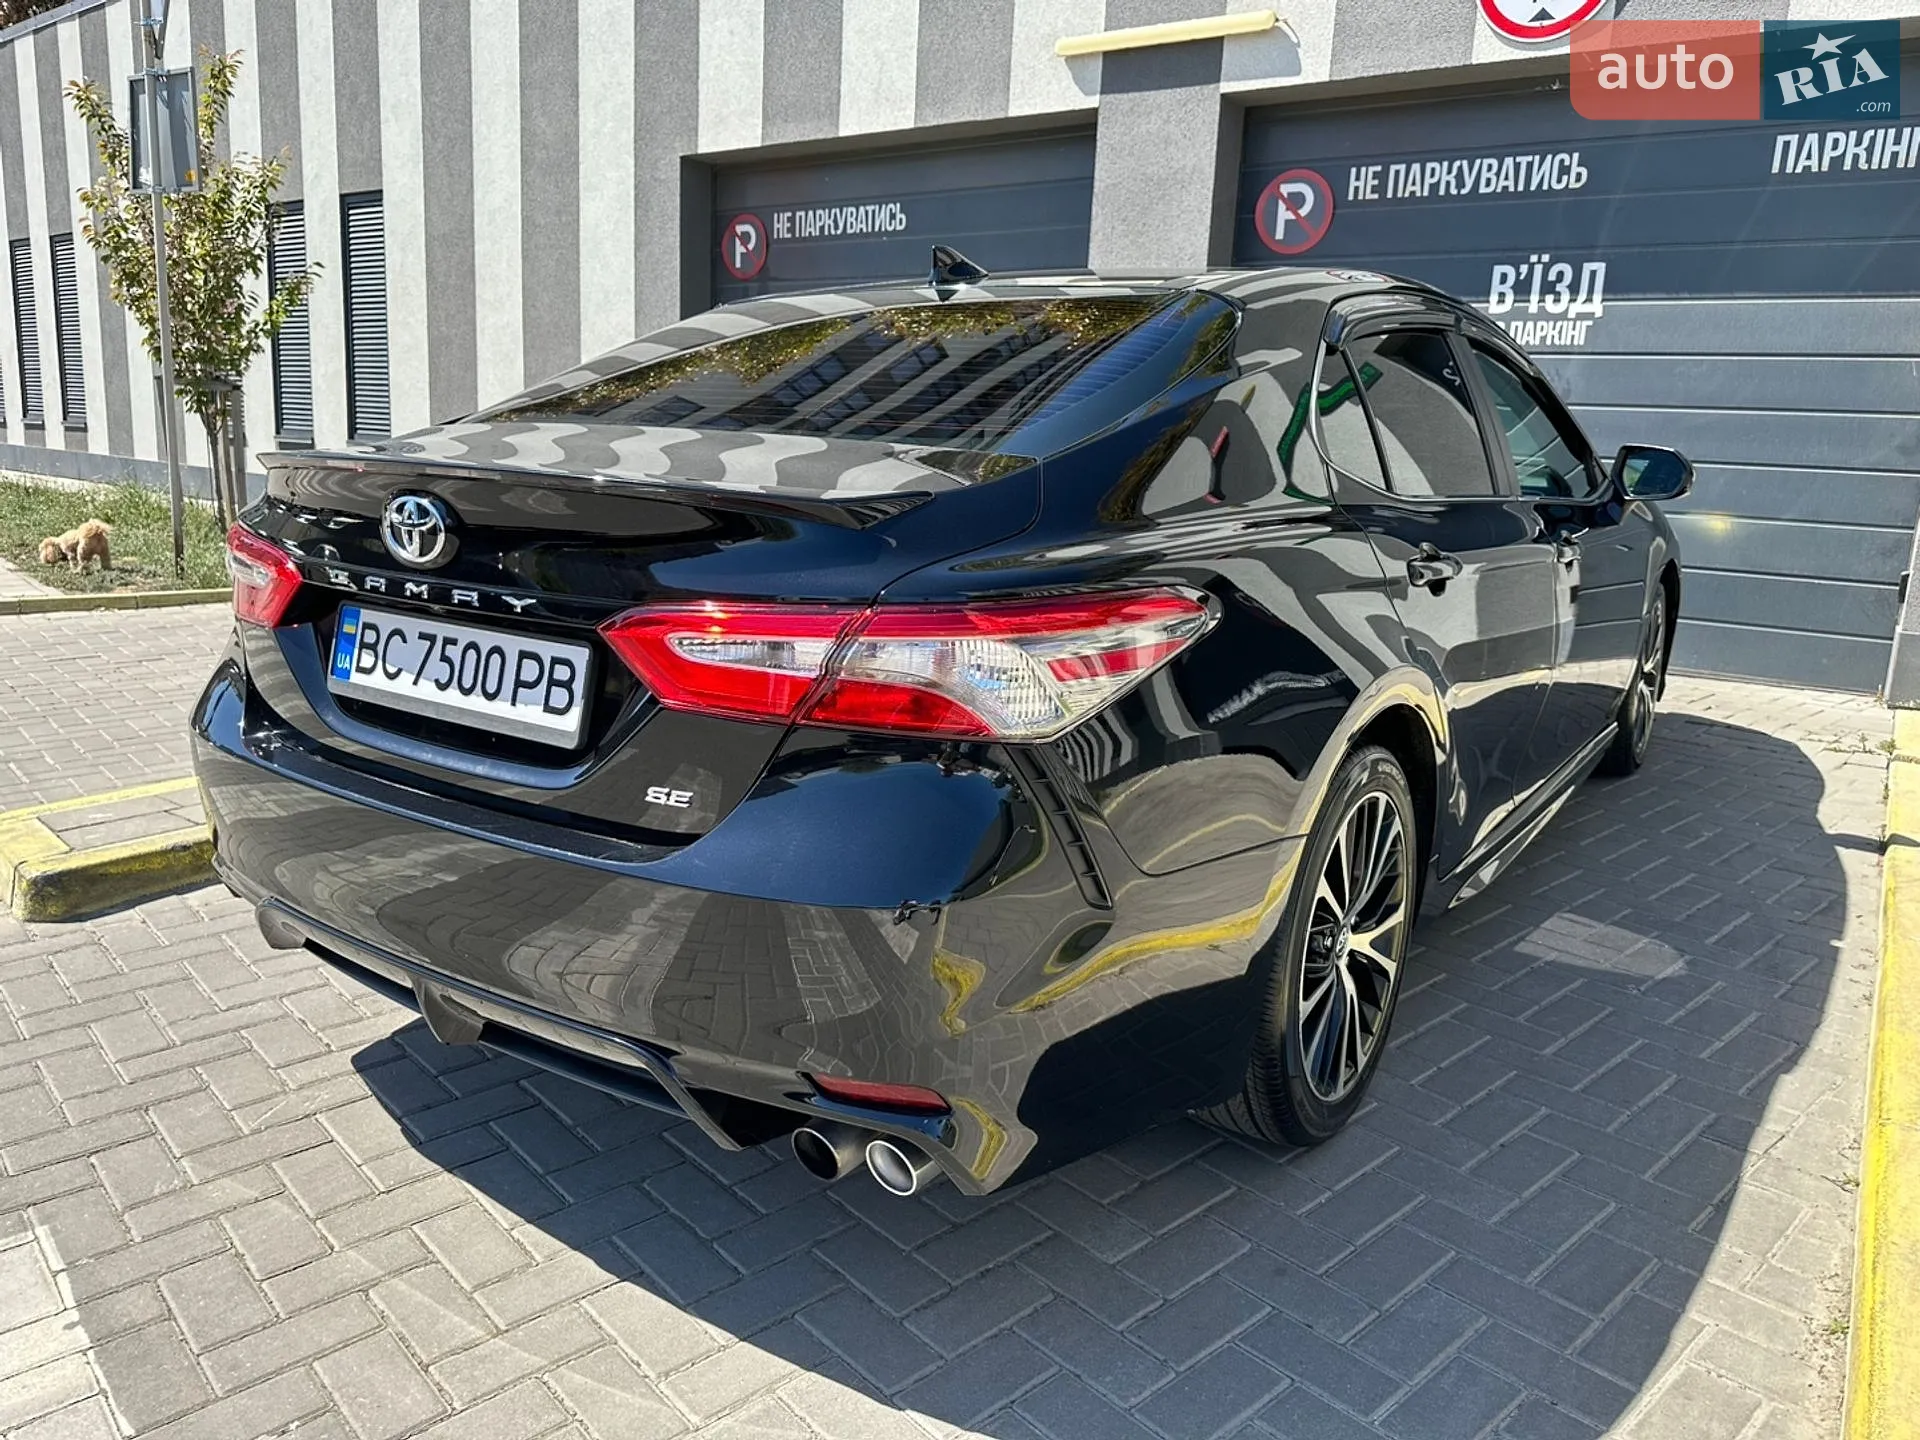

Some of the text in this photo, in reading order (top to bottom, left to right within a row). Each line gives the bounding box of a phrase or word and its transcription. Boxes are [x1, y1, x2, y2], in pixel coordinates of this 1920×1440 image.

[1347, 152, 1588, 201] НЕ ПАРКУВАТИСЬ
[773, 202, 907, 239] НЕ ПАРКУВАТИСЬ
[1487, 254, 1607, 319] В’ЇЗД
[328, 567, 537, 613] CAMRY
[336, 652, 351, 670] UA
[644, 786, 694, 808] SE
